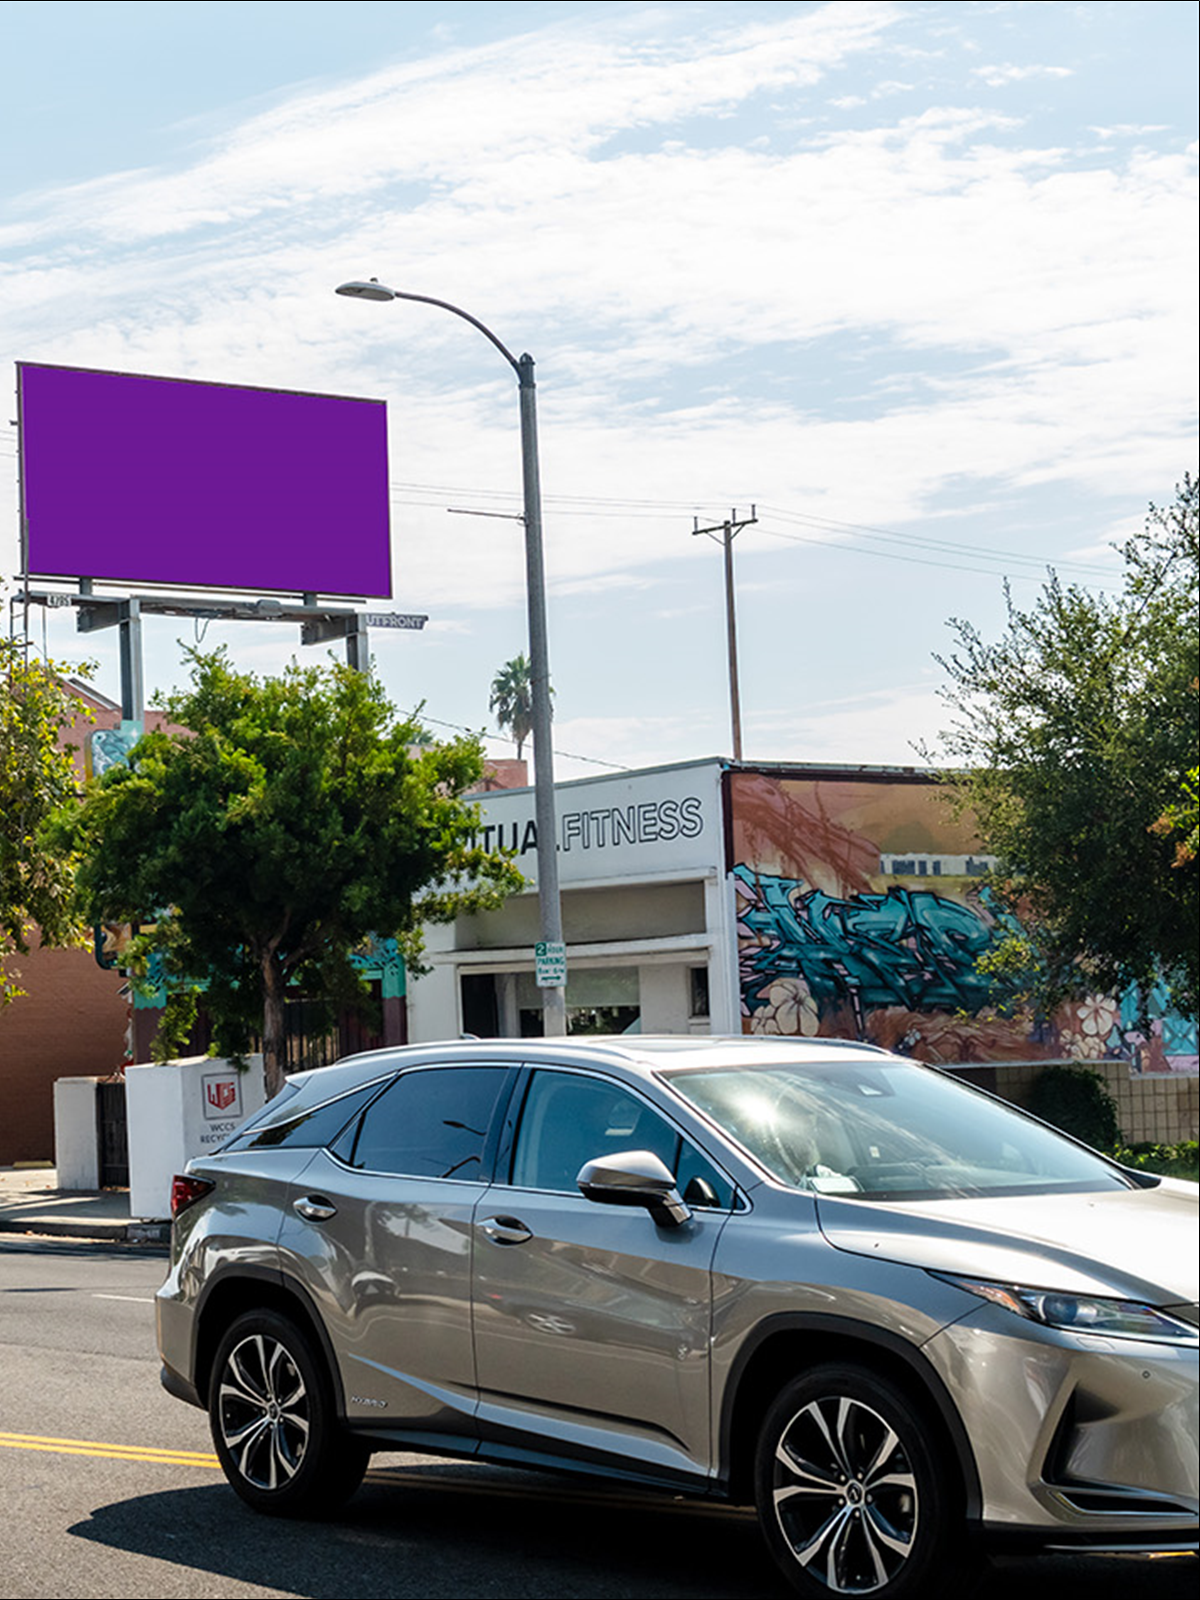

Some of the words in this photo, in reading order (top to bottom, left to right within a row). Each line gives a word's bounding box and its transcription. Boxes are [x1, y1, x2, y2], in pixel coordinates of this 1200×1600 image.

[365, 614, 423, 628] UTFRONT
[562, 796, 704, 852] FITNESS
[536, 943, 547, 956] 2
[537, 956, 566, 966] PARKING
[209, 1122, 236, 1132] WCCS
